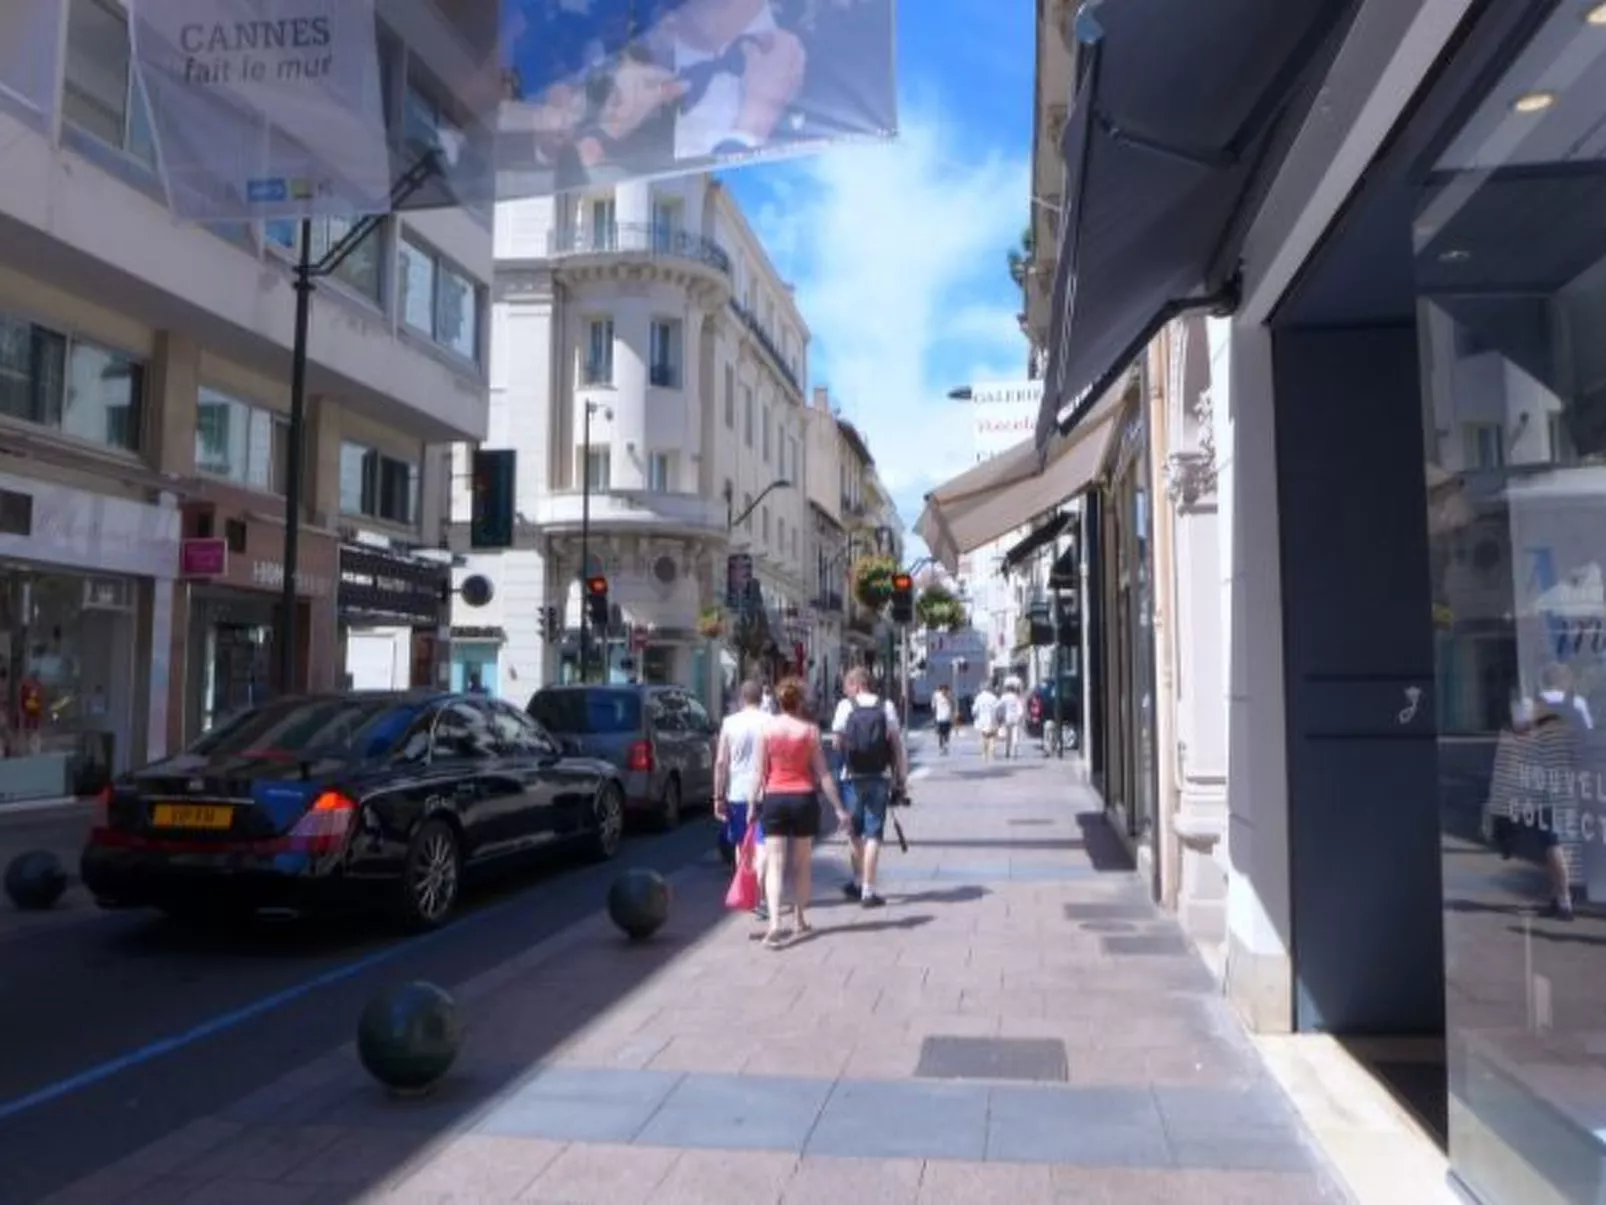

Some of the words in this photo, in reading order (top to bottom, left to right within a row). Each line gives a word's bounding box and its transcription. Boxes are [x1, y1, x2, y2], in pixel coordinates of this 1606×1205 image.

[179, 16, 332, 53] CANNES
[183, 55, 231, 85] fait
[241, 53, 267, 82] le
[276, 52, 333, 81] mur
